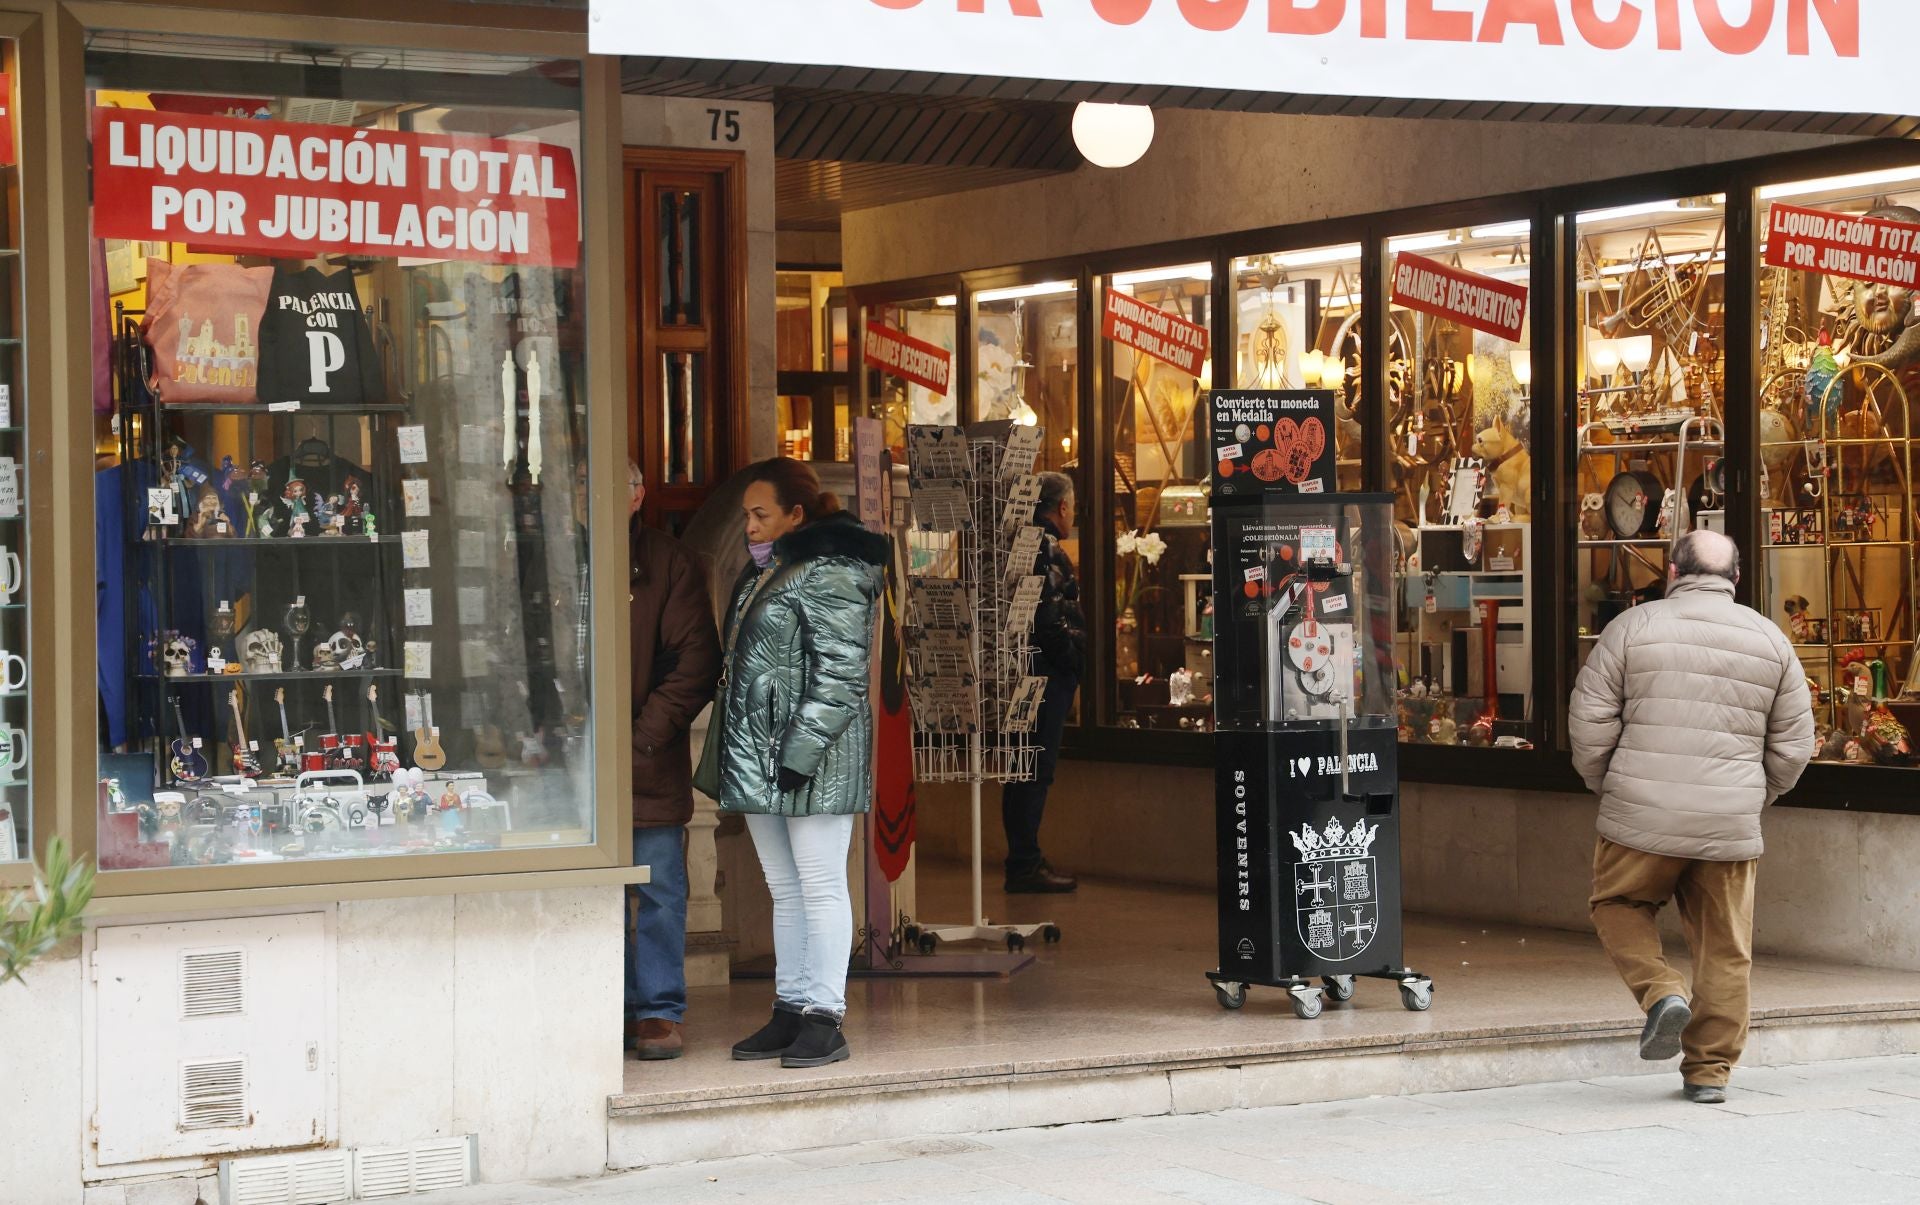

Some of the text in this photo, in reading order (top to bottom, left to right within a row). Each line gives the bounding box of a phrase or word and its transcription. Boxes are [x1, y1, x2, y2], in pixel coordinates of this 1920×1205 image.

[706, 108, 740, 142] 75
[109, 121, 566, 199] LIQUIDACIÓN TOTAL
[151, 185, 529, 254] POR JUBILACIÓN
[1773, 210, 1876, 247] LIQUIDACIÓN
[1783, 241, 1917, 284] POR JUBILACIÓN
[278, 292, 356, 315] PALENCIA
[1396, 263, 1522, 330] GRANDES DESCUENTOS
[306, 312, 338, 328] con
[1108, 293, 1204, 350] LIQUIDACIÓN TOTAL
[305, 331, 345, 393] P
[866, 331, 948, 386] GRANDES DESCUENTOS
[1113, 319, 1194, 369] POR JUBILACIÓN
[1215, 395, 1320, 409] Convierte tu moneda
[1216, 408, 1274, 422] en Medalla
[1317, 752, 1379, 776] PALNCIA
[1233, 769, 1251, 912] SOUVENIRS
